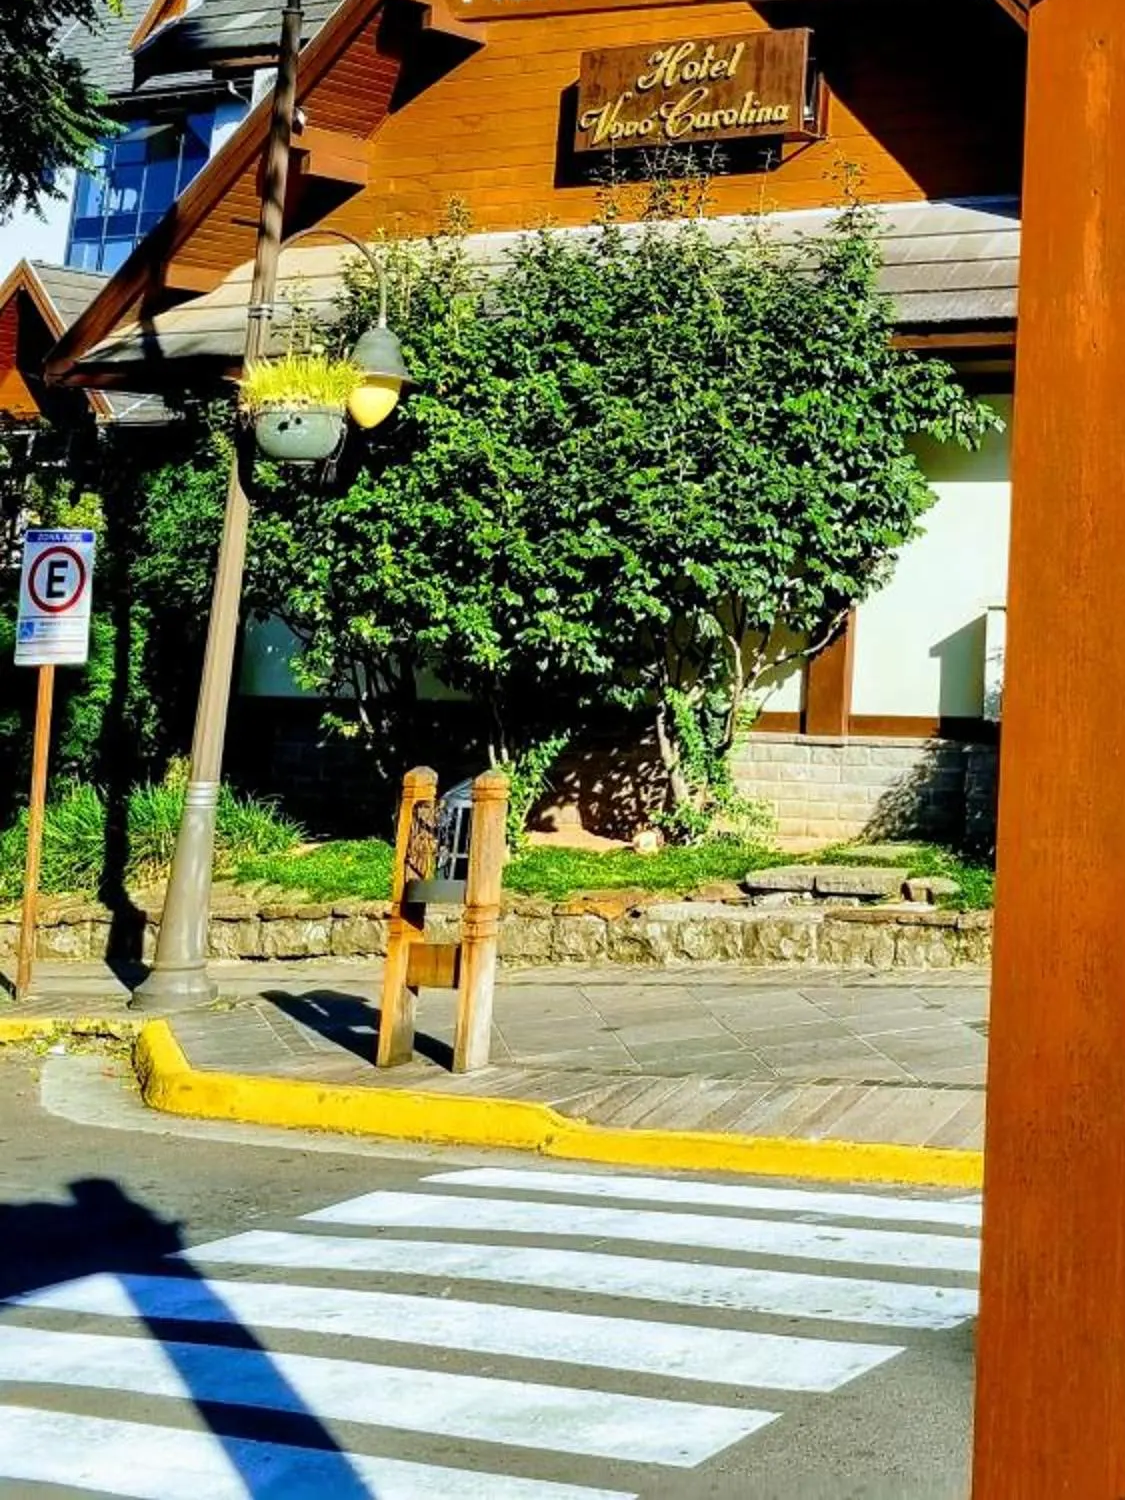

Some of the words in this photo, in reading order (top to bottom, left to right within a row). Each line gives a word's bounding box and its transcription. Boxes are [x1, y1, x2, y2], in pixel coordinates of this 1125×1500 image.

[637, 41, 746, 89] Hotel
[659, 87, 790, 139] Carolina
[46, 560, 69, 598] E
